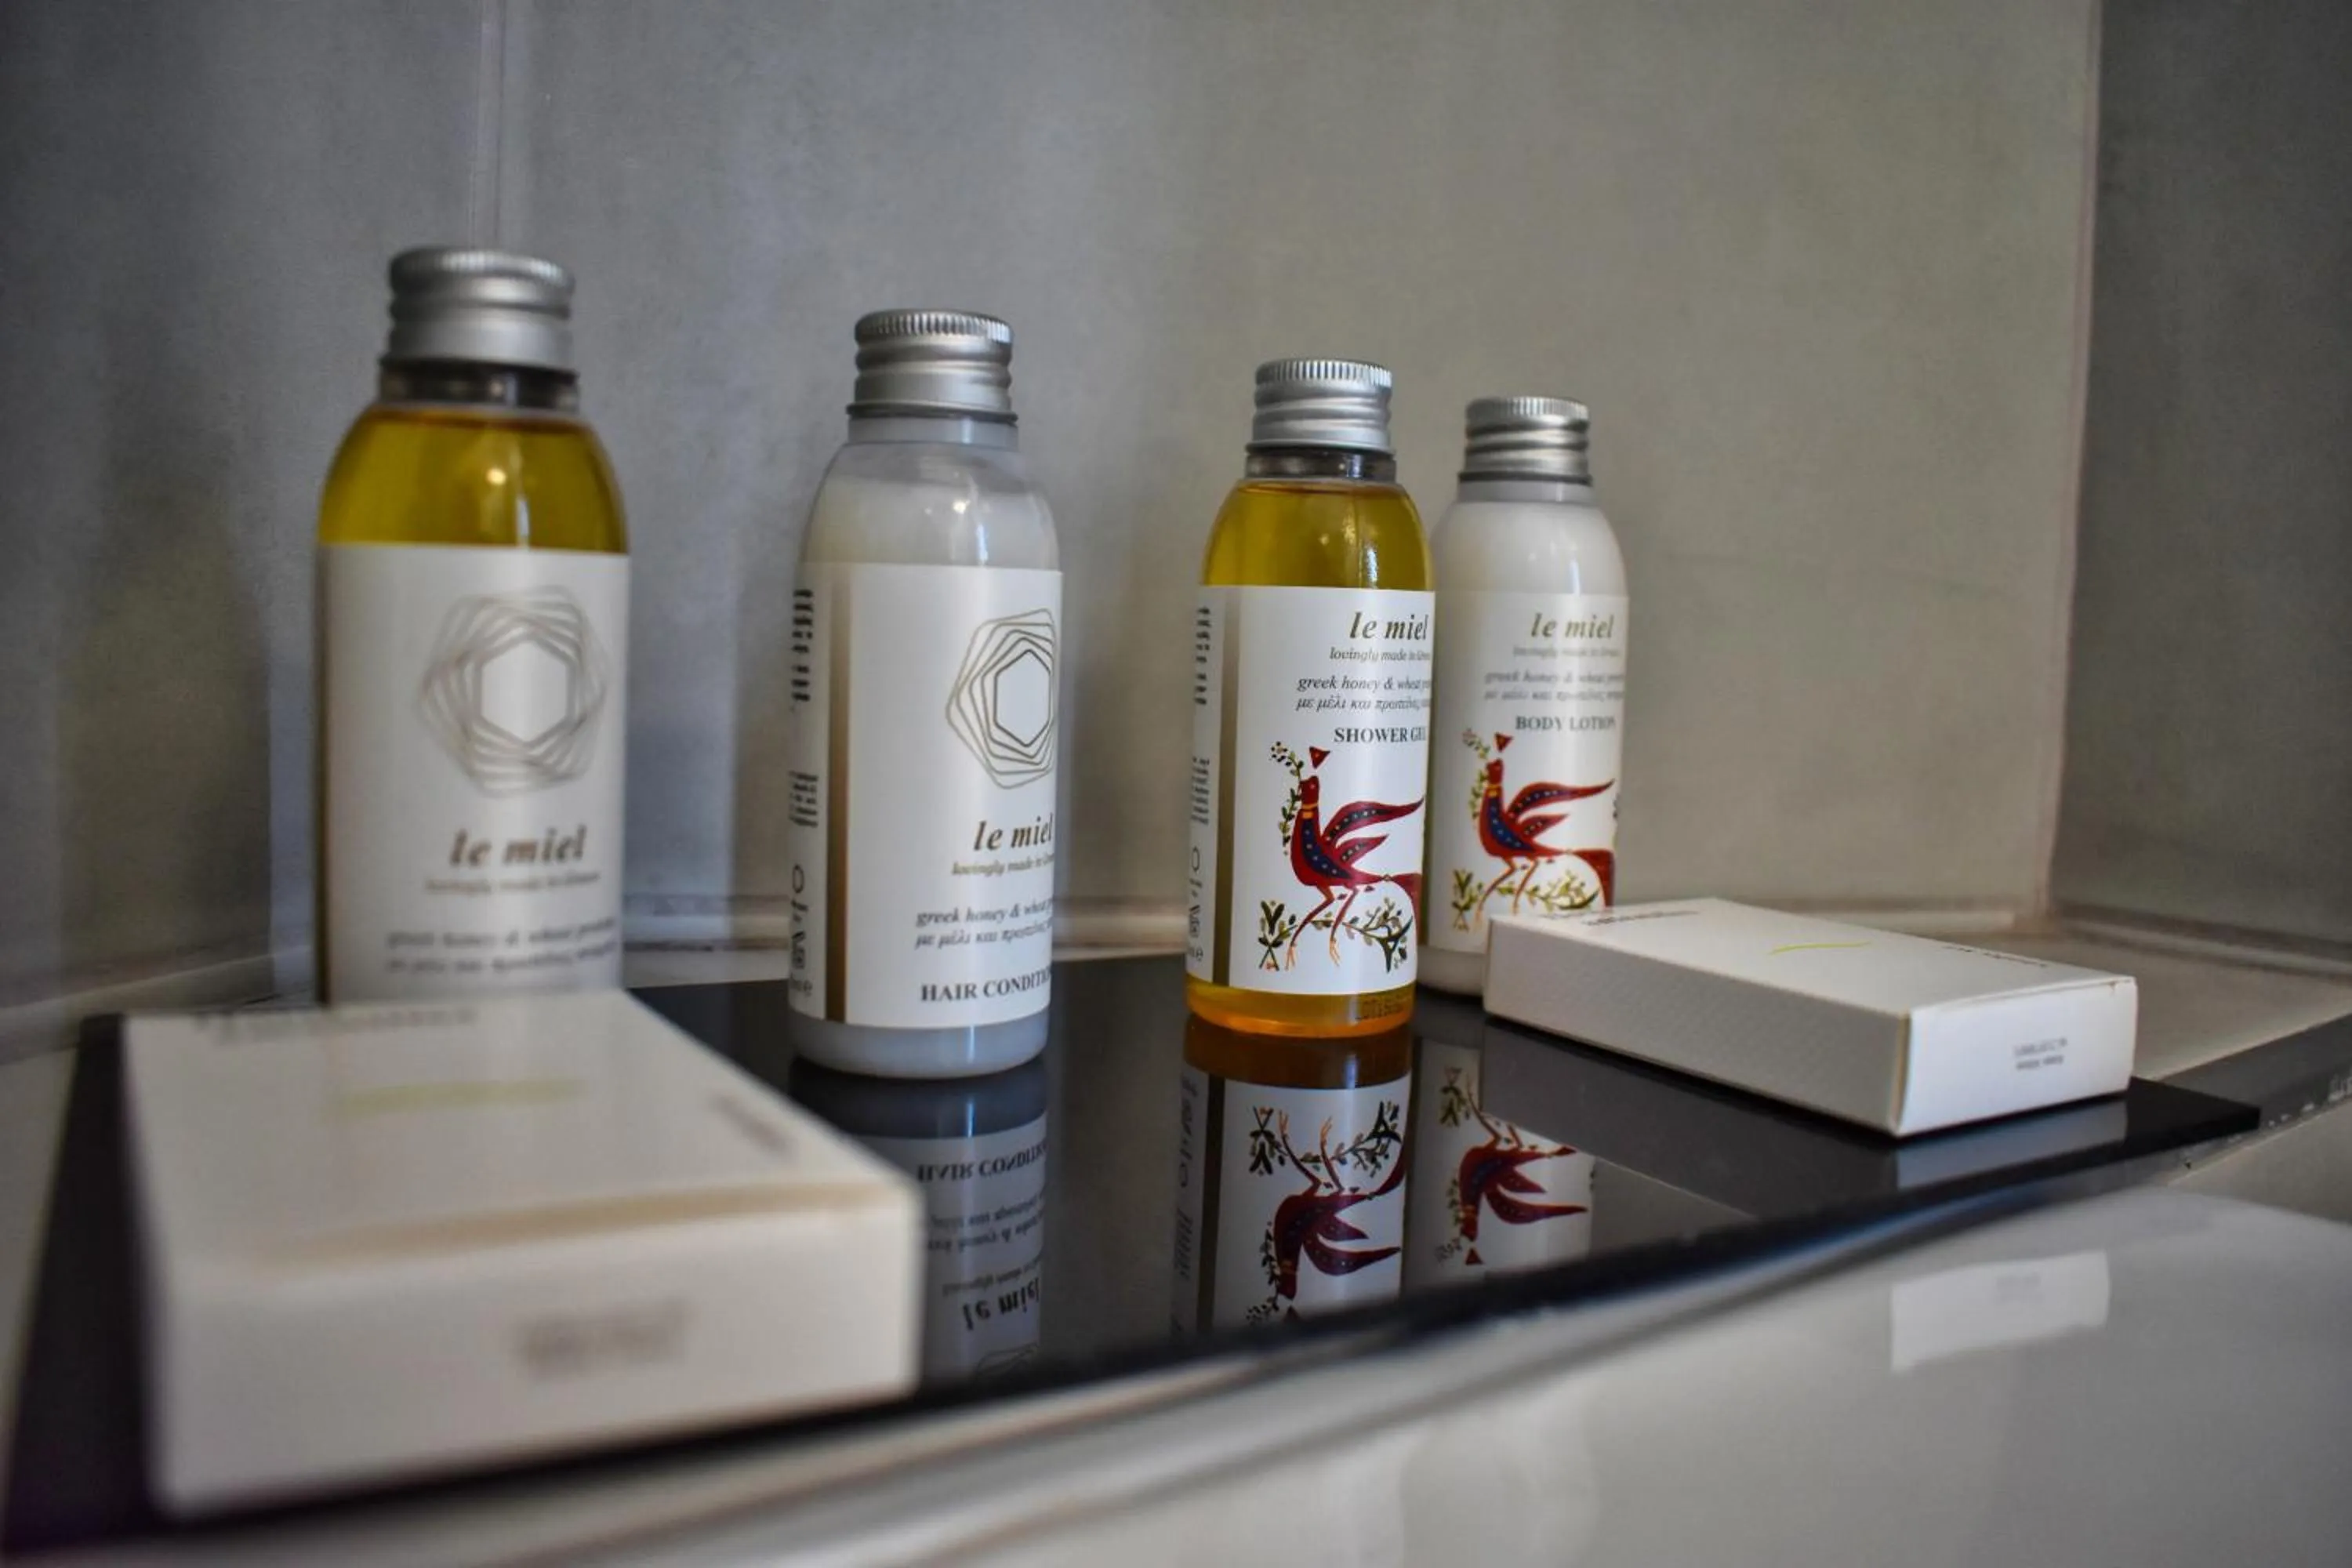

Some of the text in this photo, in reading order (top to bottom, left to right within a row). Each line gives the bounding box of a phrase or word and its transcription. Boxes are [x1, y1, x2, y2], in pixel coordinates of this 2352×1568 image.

[1349, 612, 1429, 640] le miel
[1530, 612, 1614, 639] le miel
[1329, 646, 1378, 662] lovingly
[1297, 675, 1337, 692] greek
[1341, 675, 1379, 693] honey
[1515, 716, 1563, 731] BODY
[1334, 727, 1408, 742] SHOWER
[973, 812, 1053, 851] le miel
[921, 983, 977, 1001] HAIR
